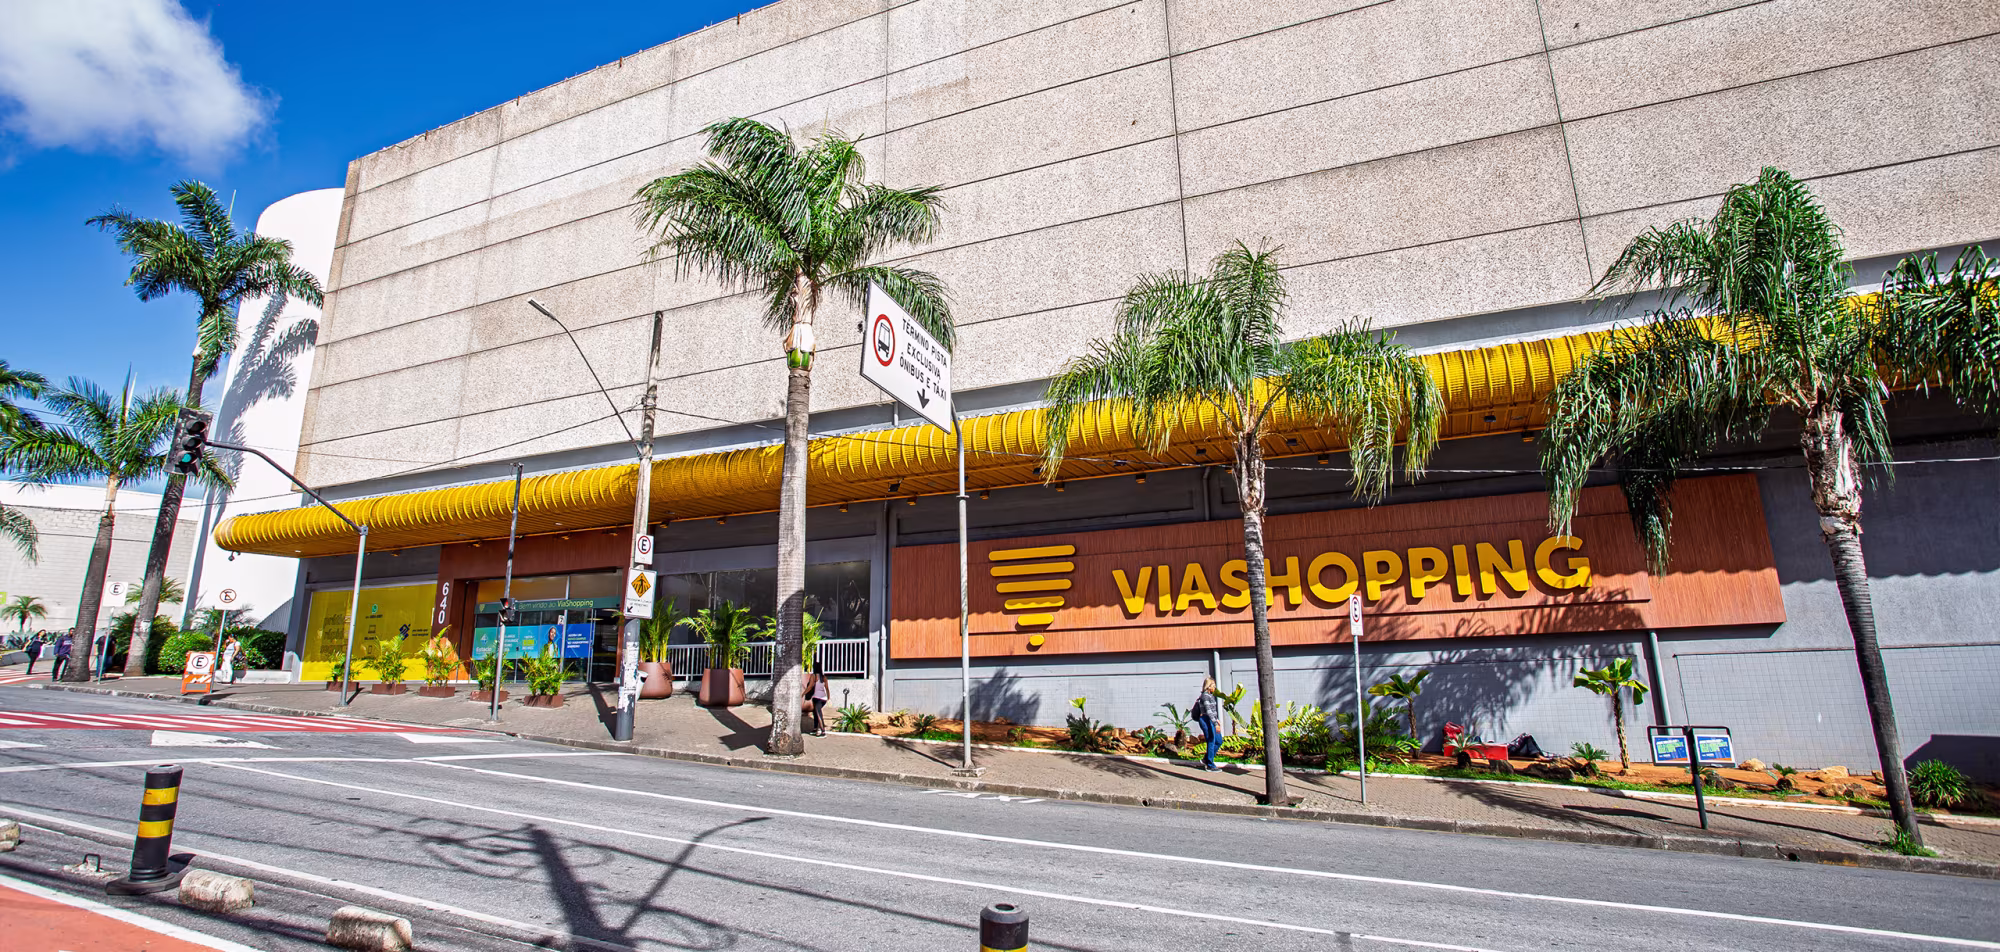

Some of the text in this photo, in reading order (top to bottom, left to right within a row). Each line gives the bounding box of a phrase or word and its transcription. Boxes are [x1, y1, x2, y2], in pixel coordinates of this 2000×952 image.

[902, 318, 947, 368] TÉRMINO PISTA
[907, 342, 941, 380] EXCLUSIVA
[899, 351, 947, 401] ÔNIBUS E TÁXI
[641, 539, 647, 551] E
[113, 584, 120, 593] E
[1112, 535, 1594, 614] VIASHOPPING
[438, 582, 450, 624] 640
[518, 602, 531, 610] Bem
[532, 601, 547, 609] vindo
[557, 599, 594, 608] ViaShopping
[195, 657, 204, 667] E
